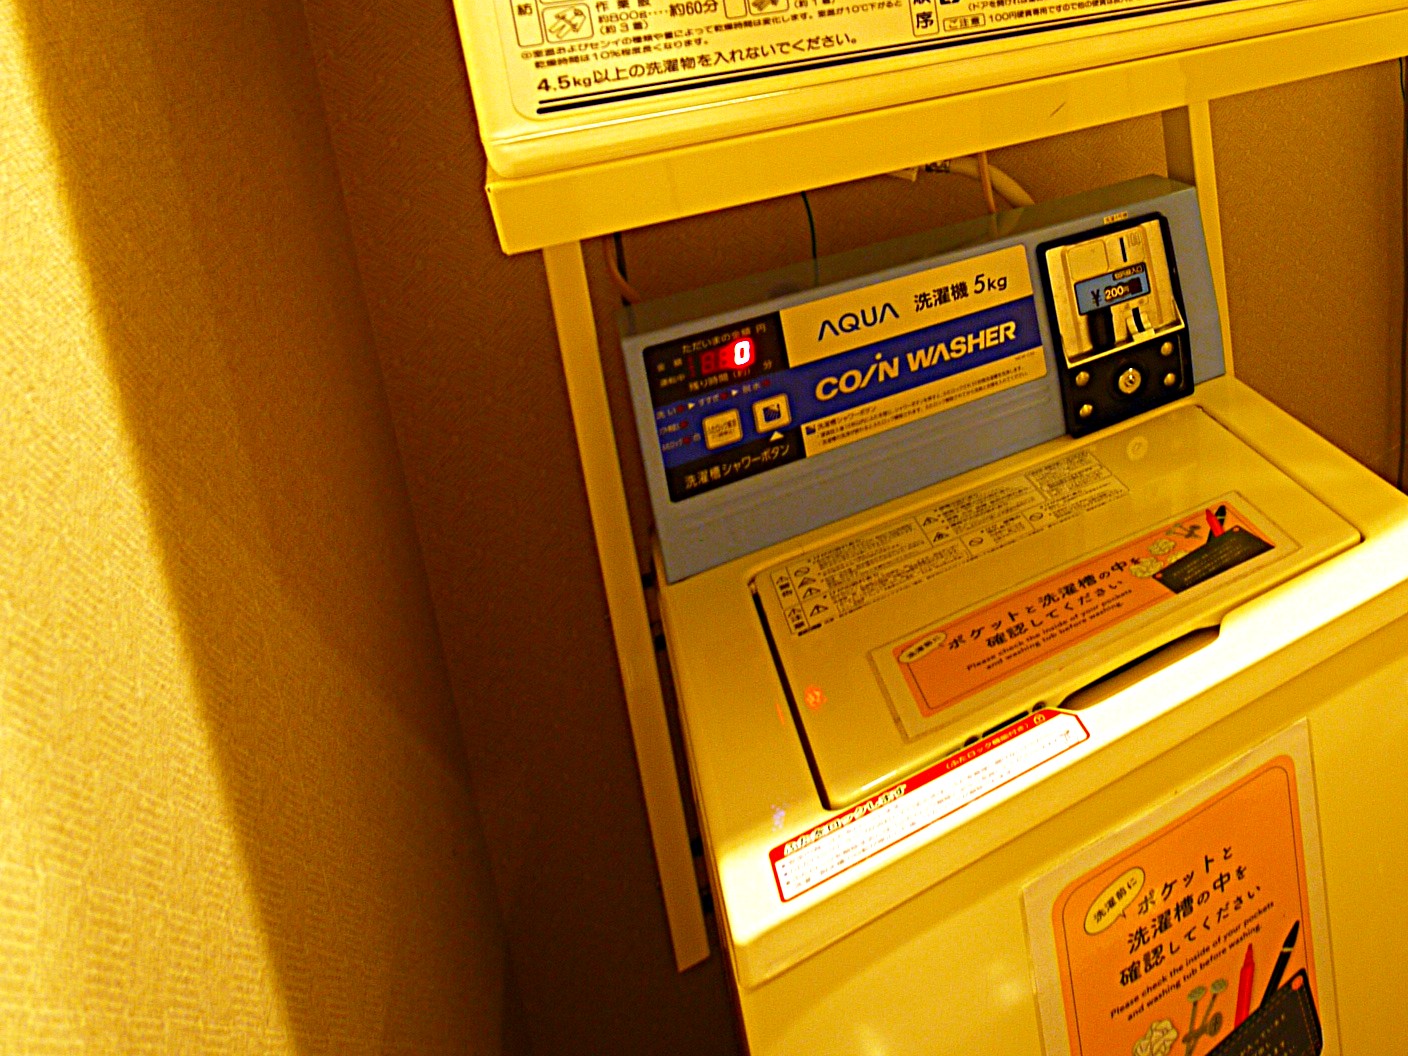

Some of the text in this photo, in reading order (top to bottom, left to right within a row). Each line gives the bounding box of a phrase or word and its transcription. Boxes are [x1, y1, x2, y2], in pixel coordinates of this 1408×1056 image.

[914, 281, 969, 312] 洗濯機
[973, 273, 1008, 295] 5kg
[818, 302, 900, 341] AQUA
[906, 320, 1017, 373] WASHER
[733, 340, 750, 366] 0
[684, 446, 790, 490] 洗濯槽シャワーボタン
[986, 580, 1123, 648] 確認してください
[1059, 617, 1087, 634] before
[966, 655, 997, 671] Please
[1026, 633, 1041, 644] the
[1042, 619, 1068, 636] inside
[1138, 846, 1233, 916] ポケットと
[1119, 885, 1261, 987] 確認してください
[1127, 865, 1247, 955] 洗濯槽の中を
[1110, 901, 1275, 1019] Please check the inside of your pockets
[1127, 1004, 1145, 1021] and
[1149, 981, 1181, 1005] washing
[1183, 968, 1198, 983] tub
[1200, 945, 1227, 970] before
